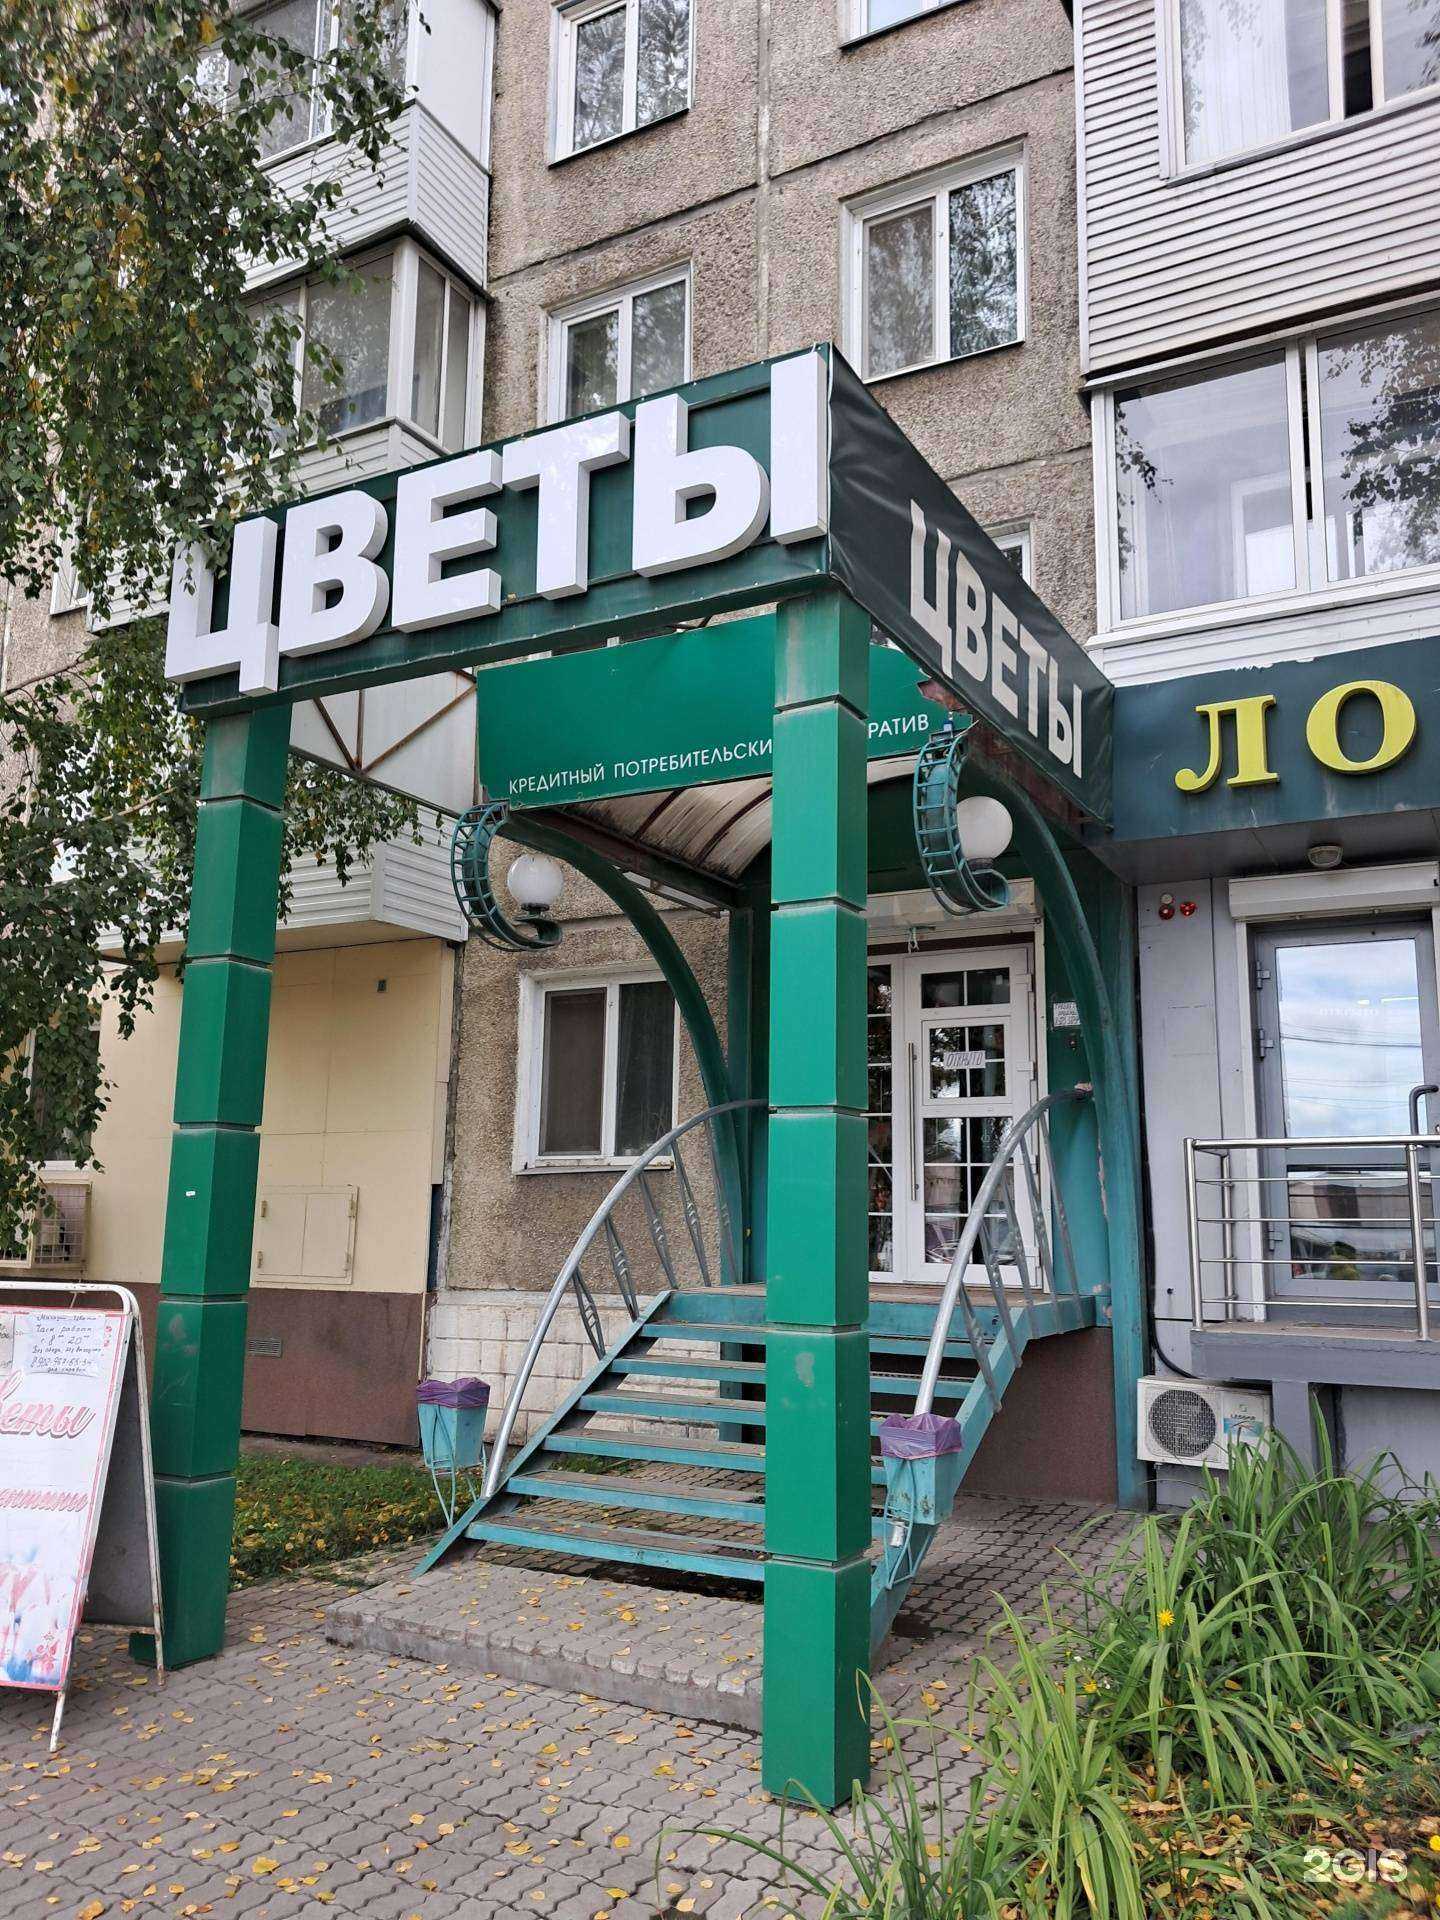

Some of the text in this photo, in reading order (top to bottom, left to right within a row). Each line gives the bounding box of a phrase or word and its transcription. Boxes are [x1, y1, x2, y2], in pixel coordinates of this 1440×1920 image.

[164, 351, 828, 697] ЦВЕТЫ
[910, 499, 1082, 779] ЦВЕТЫ
[508, 713, 930, 795] КРЕДИТНЫЙ ПОТРЕБИТЕЛЬСКИ РАТИВ
[1174, 679, 1417, 793] ЛО
[946, 1052, 983, 1067] ОТКРЫТО
